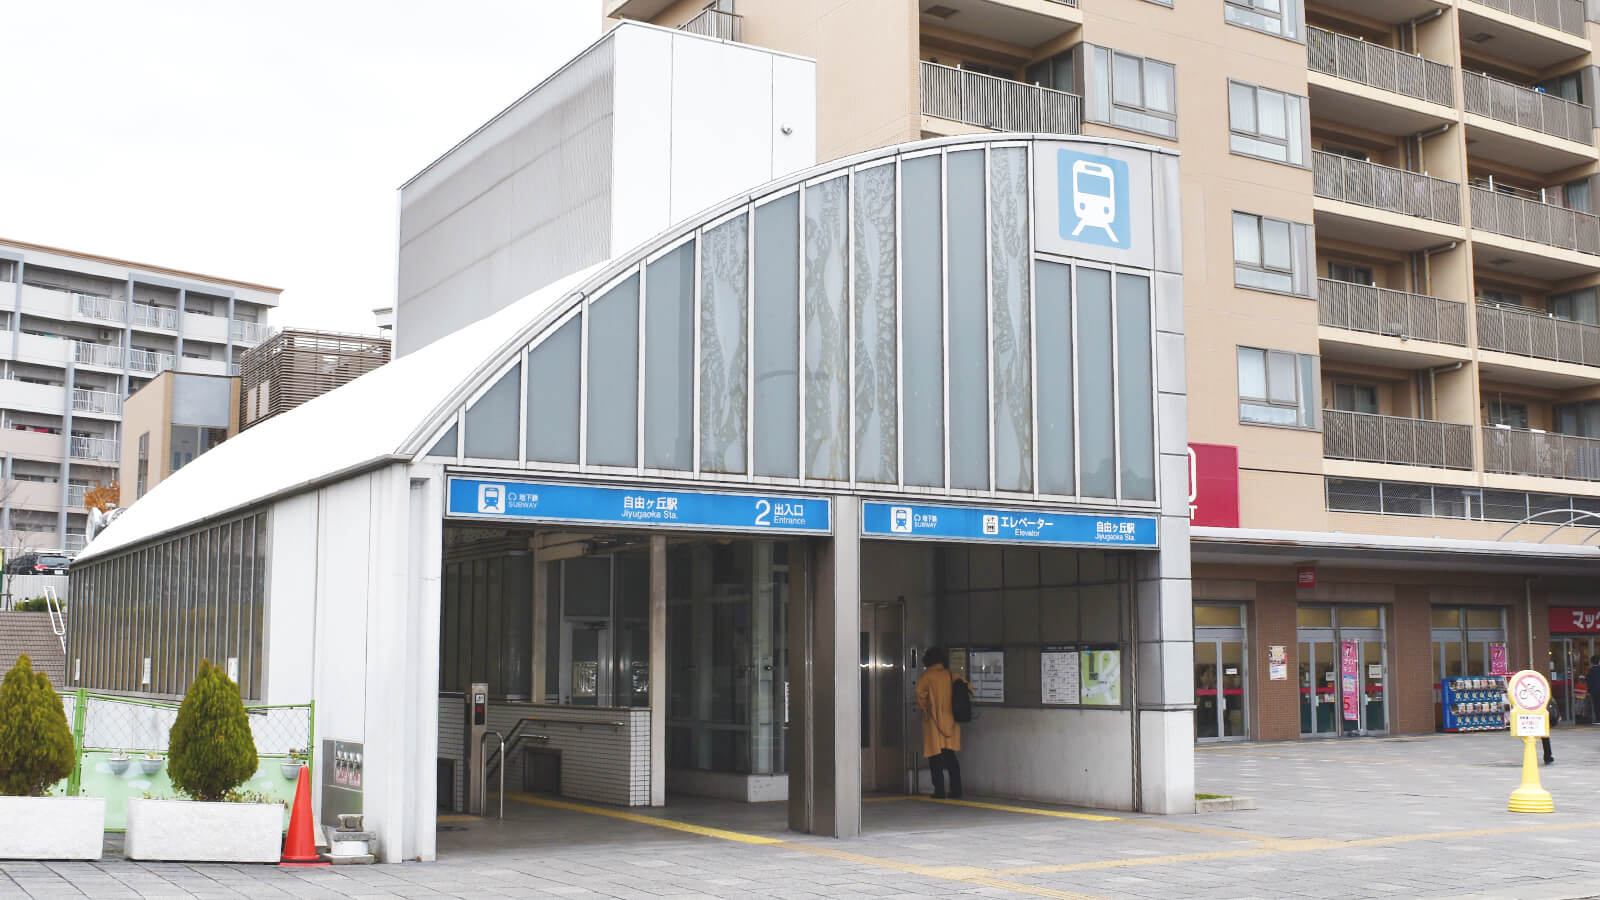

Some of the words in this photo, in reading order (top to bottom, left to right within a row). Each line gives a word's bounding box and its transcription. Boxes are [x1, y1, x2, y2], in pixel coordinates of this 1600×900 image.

[508, 501, 537, 509] SUBWAY
[774, 503, 804, 516] 出入口
[621, 510, 661, 519] Jiyugaoka
[663, 510, 678, 519] Sta.
[755, 499, 771, 526] 2
[774, 515, 806, 525] Entrance
[1000, 516, 1054, 529] エレベーター
[1014, 528, 1040, 537] Elevator
[1095, 532, 1124, 541] Jiyugaoka
